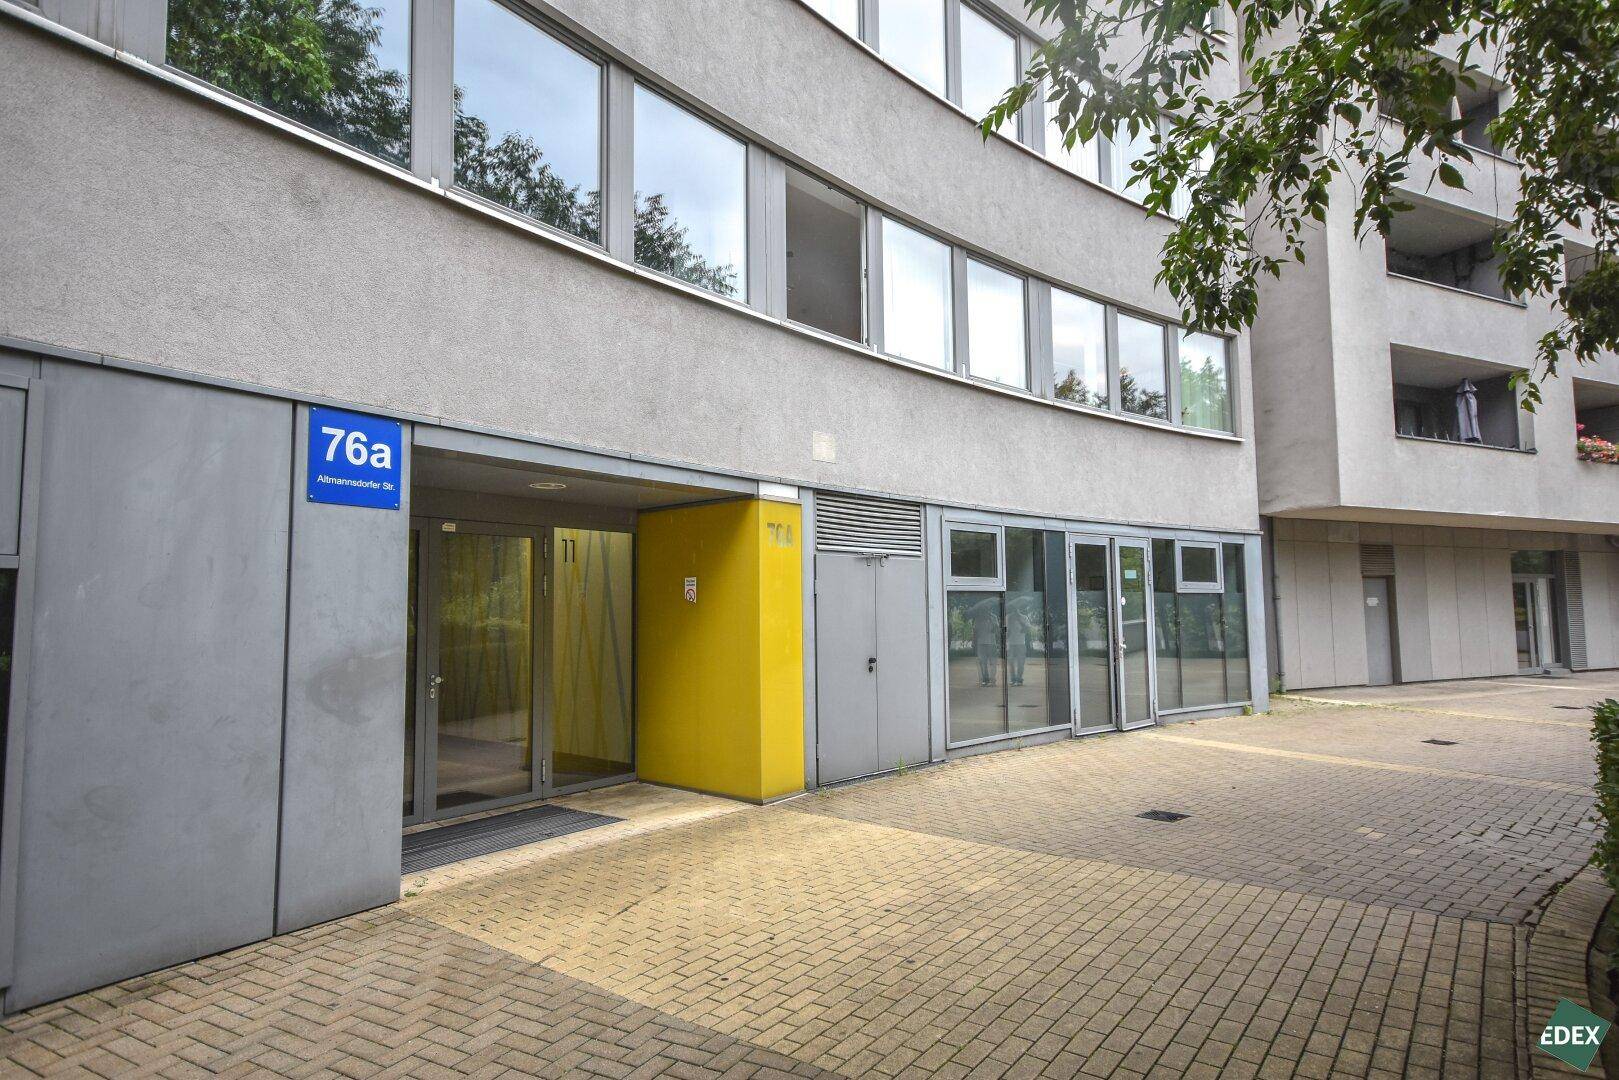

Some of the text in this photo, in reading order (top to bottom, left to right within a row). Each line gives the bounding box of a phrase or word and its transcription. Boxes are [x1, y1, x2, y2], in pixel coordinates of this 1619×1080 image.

[321, 426, 392, 470] 76a
[317, 474, 396, 491] Altmannsdorfer Str.
